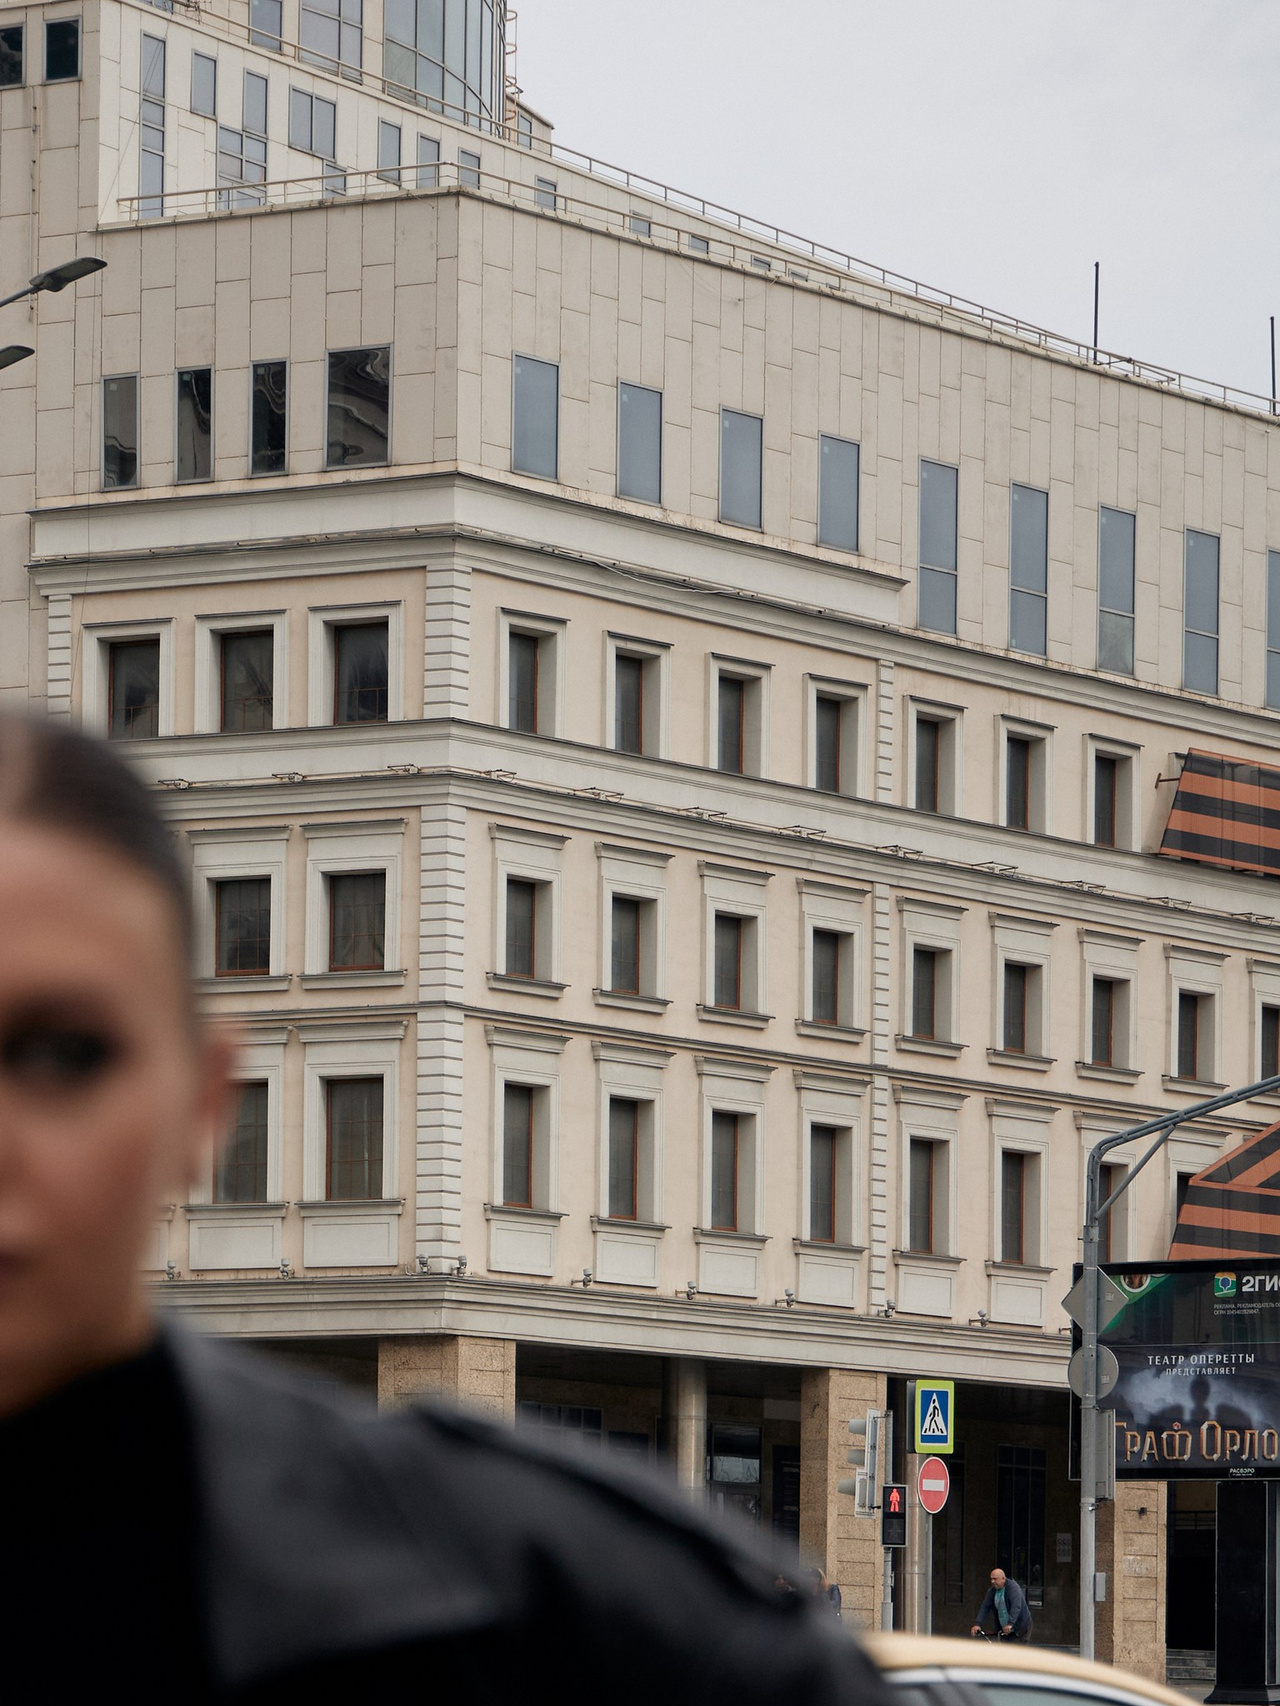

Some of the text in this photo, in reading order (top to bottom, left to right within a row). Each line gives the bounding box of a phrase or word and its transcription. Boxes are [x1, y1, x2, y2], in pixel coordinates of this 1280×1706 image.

[1241, 1275, 1280, 1292] 2ГИ
[1147, 1353, 1255, 1366] ТЕАТР ОПЕРЕТТЫ
[1165, 1367, 1236, 1376] ПРЕДСТАВЛЯЕТ
